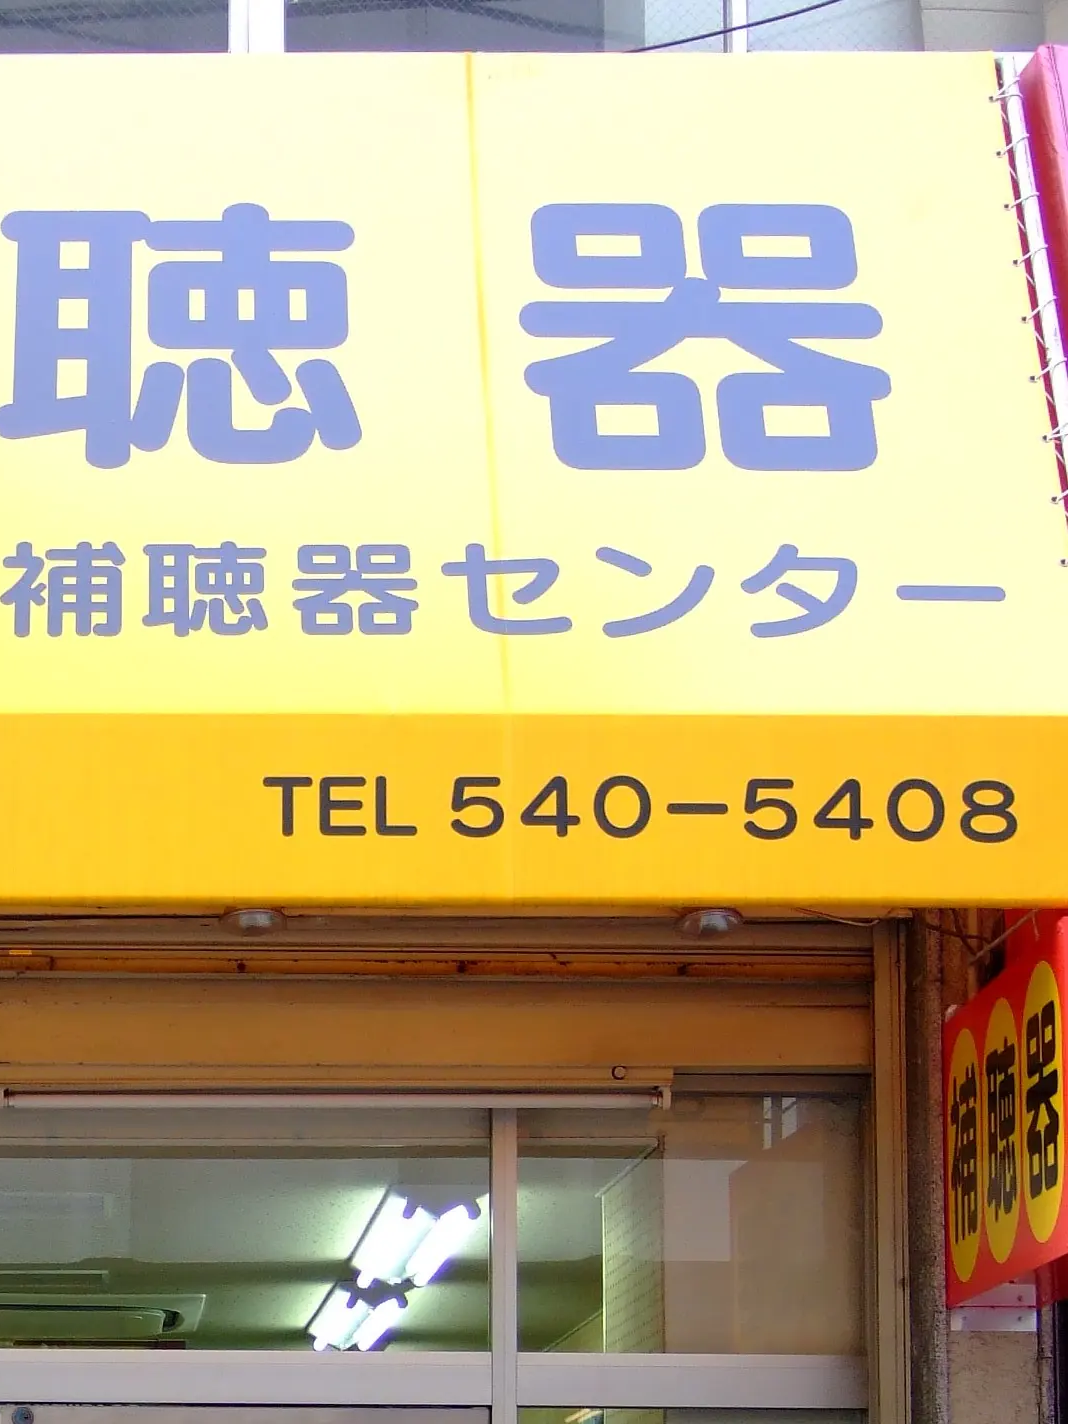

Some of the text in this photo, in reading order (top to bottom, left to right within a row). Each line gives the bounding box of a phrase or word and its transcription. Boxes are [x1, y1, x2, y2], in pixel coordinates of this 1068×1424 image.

[263, 774, 1019, 844] TEL 540-5408
[950, 999, 1059, 1245] 補聴器
